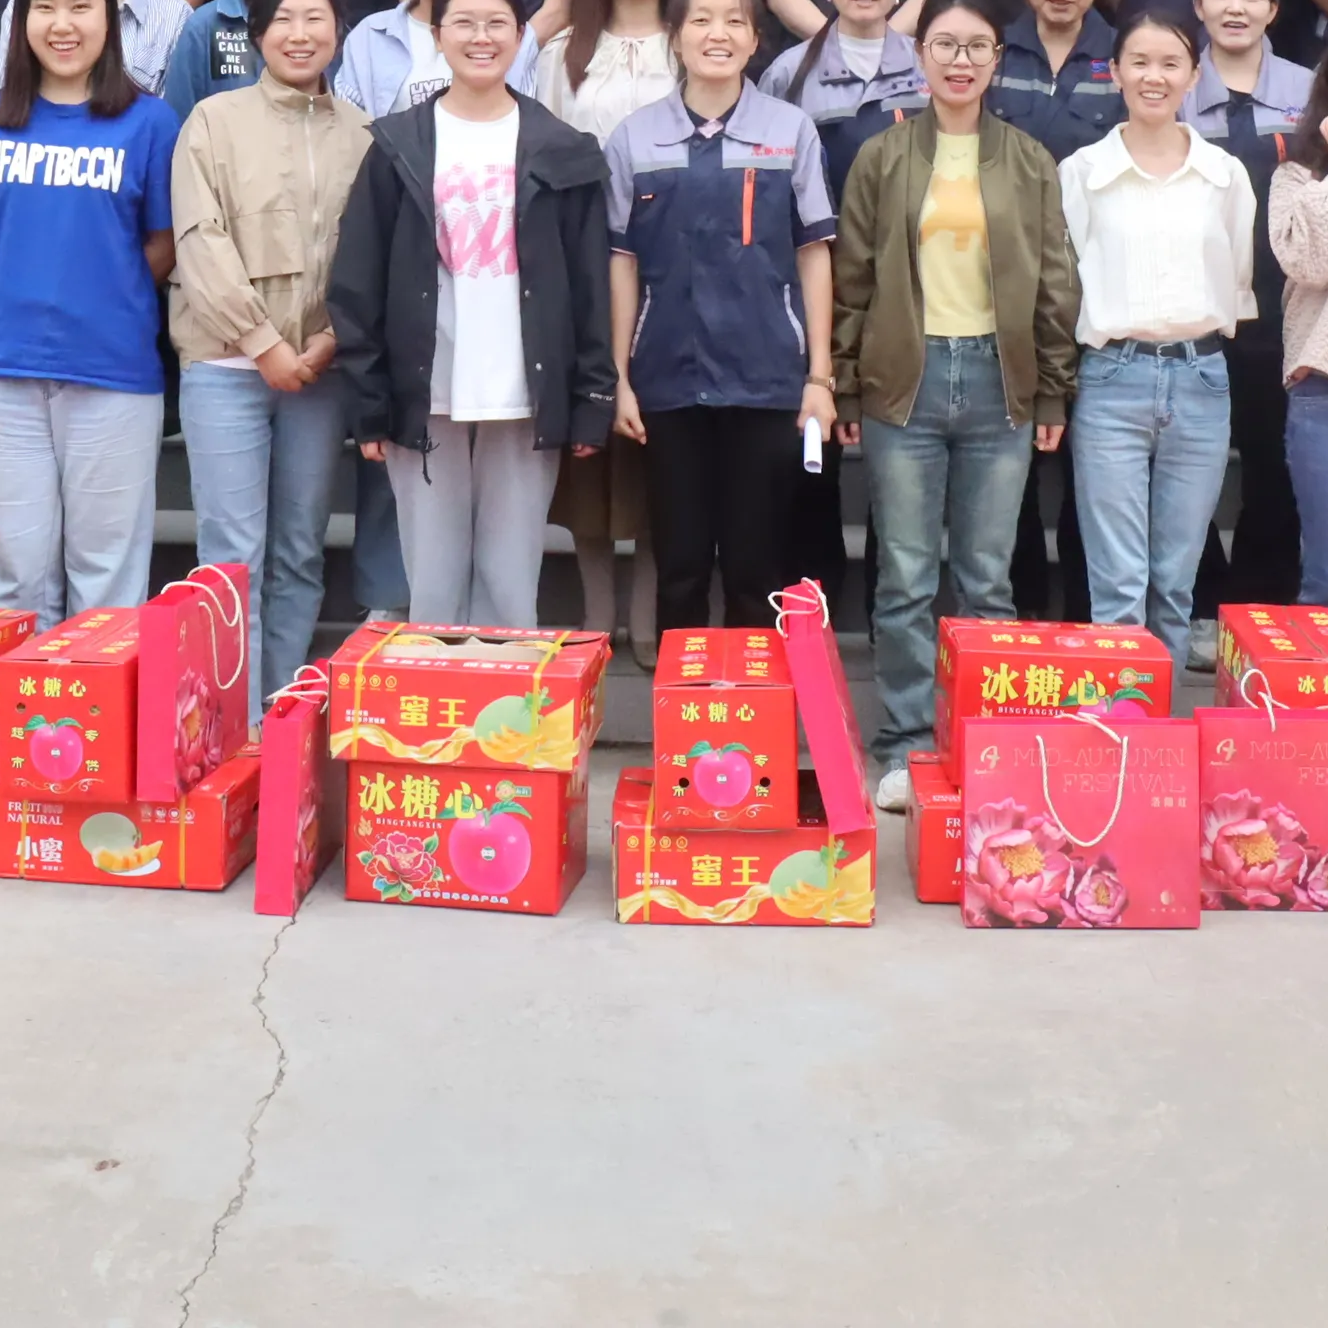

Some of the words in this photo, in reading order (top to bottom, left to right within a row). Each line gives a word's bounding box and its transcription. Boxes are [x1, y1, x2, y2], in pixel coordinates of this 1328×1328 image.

[216, 31, 248, 41] PLEASE
[218, 41, 248, 53] CALL
[220, 64, 247, 75] GIRL
[226, 54, 240, 64] ME
[17, 621, 28, 635] AA
[19, 676, 86, 698] 冰糖心
[980, 663, 1106, 707] 冰糖心
[399, 695, 466, 728] 蜜王
[681, 702, 755, 723] 冰糖心
[359, 772, 483, 820] 冰糖心
[376, 817, 443, 829] BINGTANGXIN
[16, 836, 63, 863] 小蜜
[691, 855, 762, 886] 蜜王
